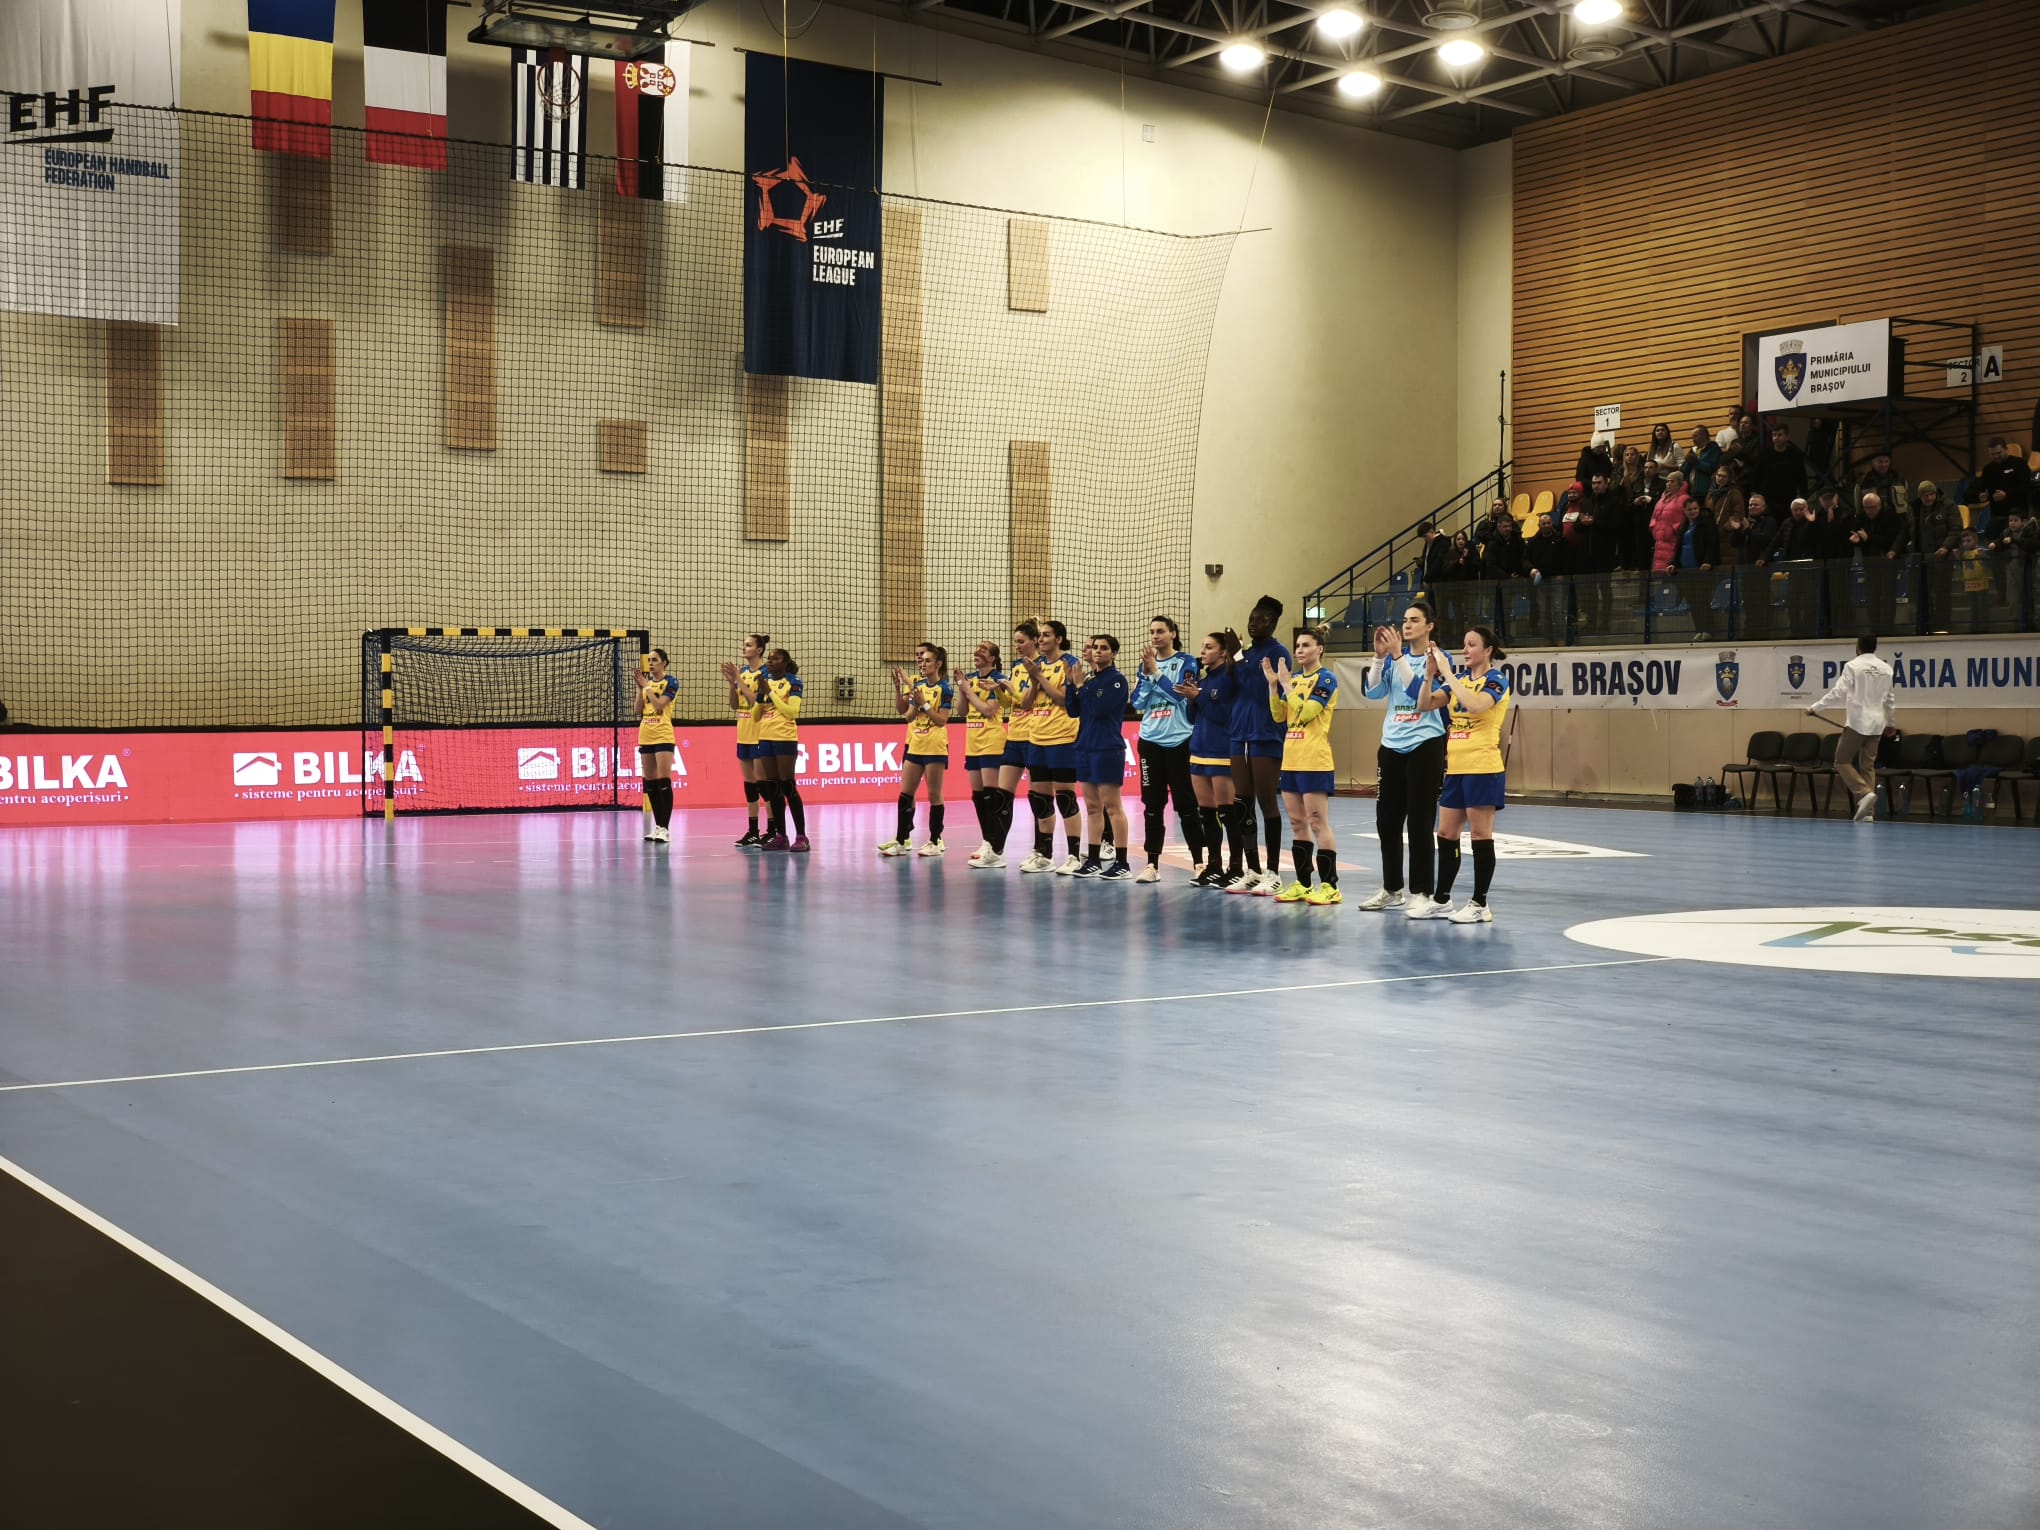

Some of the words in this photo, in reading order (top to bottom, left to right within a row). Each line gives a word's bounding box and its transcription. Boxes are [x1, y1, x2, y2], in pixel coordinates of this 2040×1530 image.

[9, 84, 115, 132] EHF
[45, 149, 107, 172] EUROPEAN
[109, 156, 170, 179] HANDBALL
[45, 167, 115, 192] FEDERATION
[813, 219, 844, 235] EHF
[813, 245, 875, 269] EUROPEAN
[812, 264, 856, 286] LEAGUE
[1810, 351, 1854, 366] PRIMĂRIA
[1983, 355, 2000, 378] A
[1810, 363, 1871, 380] MUNICIPIULUI
[1960, 371, 1968, 383] 2
[1810, 380, 1846, 394] BRAȘOV
[1595, 406, 1620, 416] SECTOR
[1823, 652, 1957, 688] PĂRIA
[1500, 662, 1564, 697] OCAL
[1572, 660, 1682, 705] BRAȘOV
[294, 750, 423, 784] BILKA
[572, 746, 688, 779] BILA
[818, 742, 903, 773] BILK
[525, 782, 571, 793] sisteme
[821, 777, 857, 788] pentru
[41, 790, 122, 807] acoperișuri
[242, 788, 294, 800] sisteme
[297, 788, 341, 802] pentru
